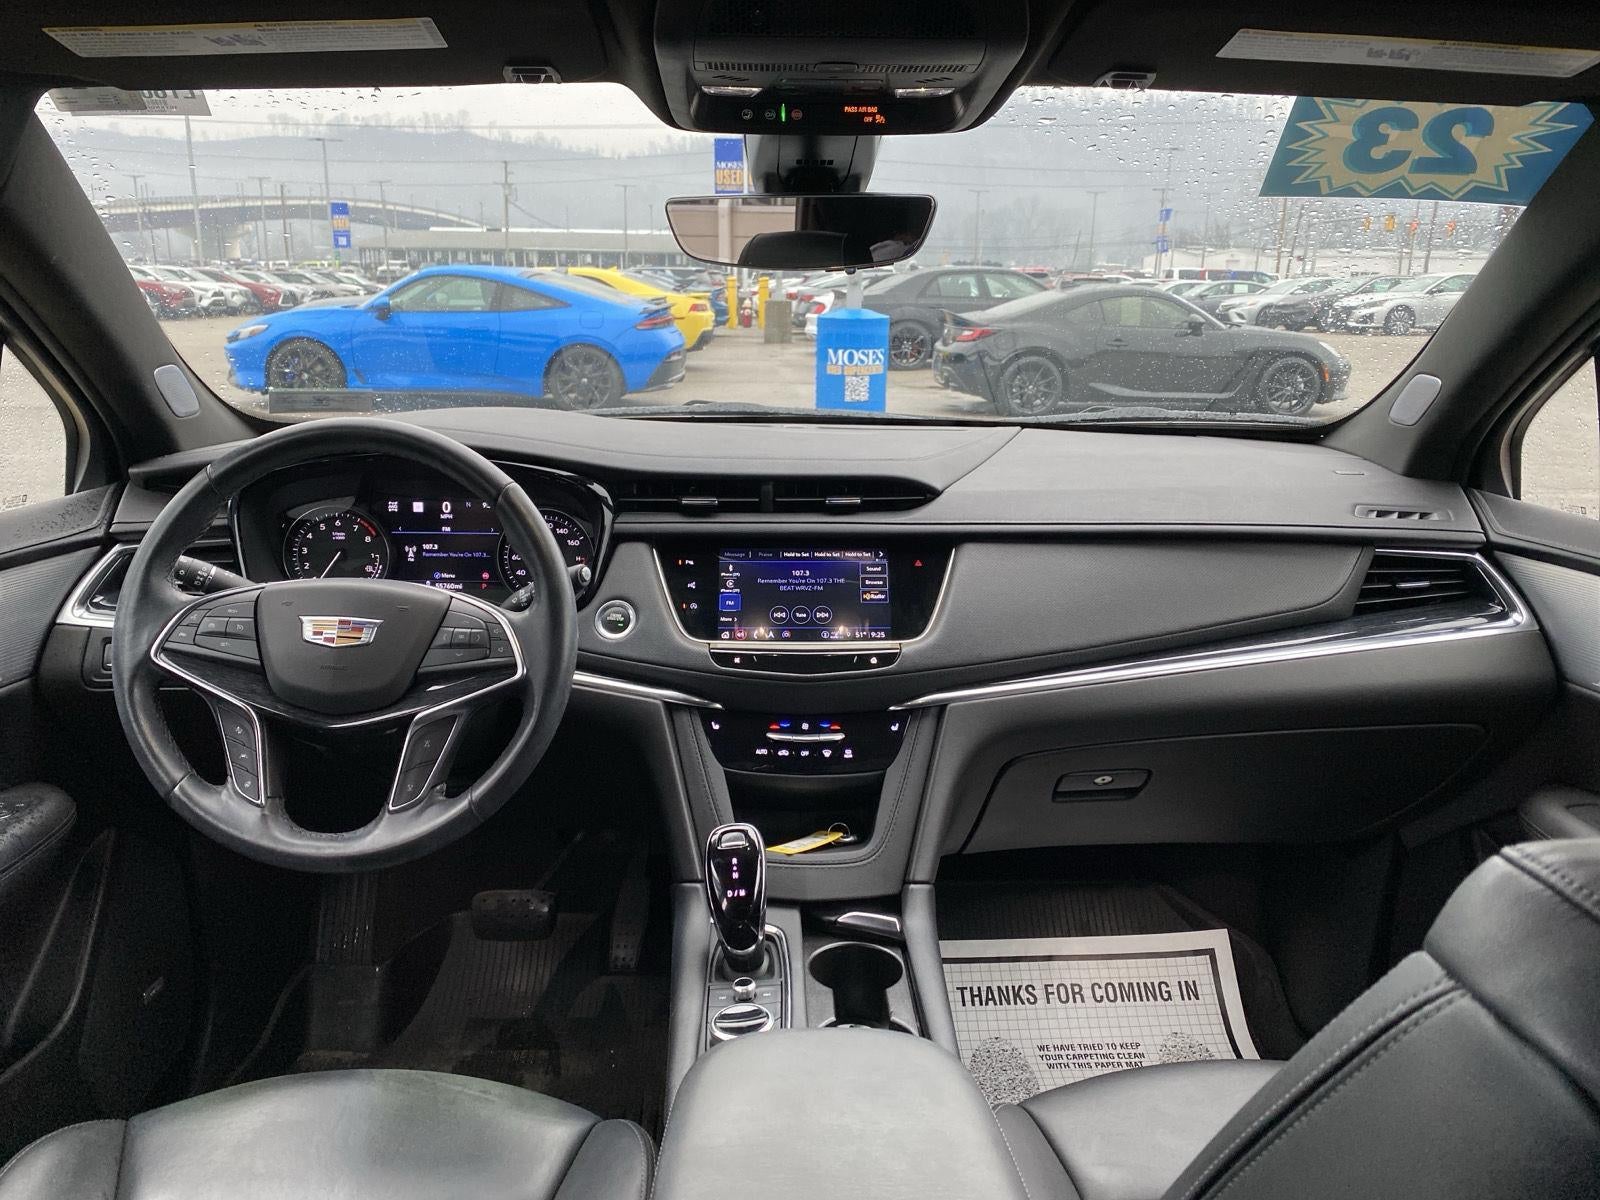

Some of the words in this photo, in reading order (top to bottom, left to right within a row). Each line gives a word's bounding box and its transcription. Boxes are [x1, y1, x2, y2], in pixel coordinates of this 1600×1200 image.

[716, 169, 743, 185] USED
[827, 348, 885, 365] MOSES
[442, 501, 451, 513] 0
[303, 562, 310, 570] 2
[956, 984, 1038, 1007] THANKS
[1043, 982, 1085, 1005] FOR
[1091, 980, 1173, 1003] COMING
[1177, 979, 1201, 1001] IN
[1036, 1044, 1051, 1052] WE
[1053, 1043, 1077, 1052] HAVE
[1077, 1043, 1104, 1051] TRIED
[1107, 1043, 1117, 1051] TO
[1119, 1042, 1141, 1050] KEEP
[1038, 1053, 1064, 1061] YOUR
[1065, 1053, 1115, 1061] CARPETING
[1116, 1052, 1146, 1060] CLEAN
[1046, 1062, 1071, 1070] WITH
[1072, 1061, 1093, 1069] THIS
[1094, 1061, 1124, 1069] PAPER
[1125, 1060, 1145, 1068] MAT
